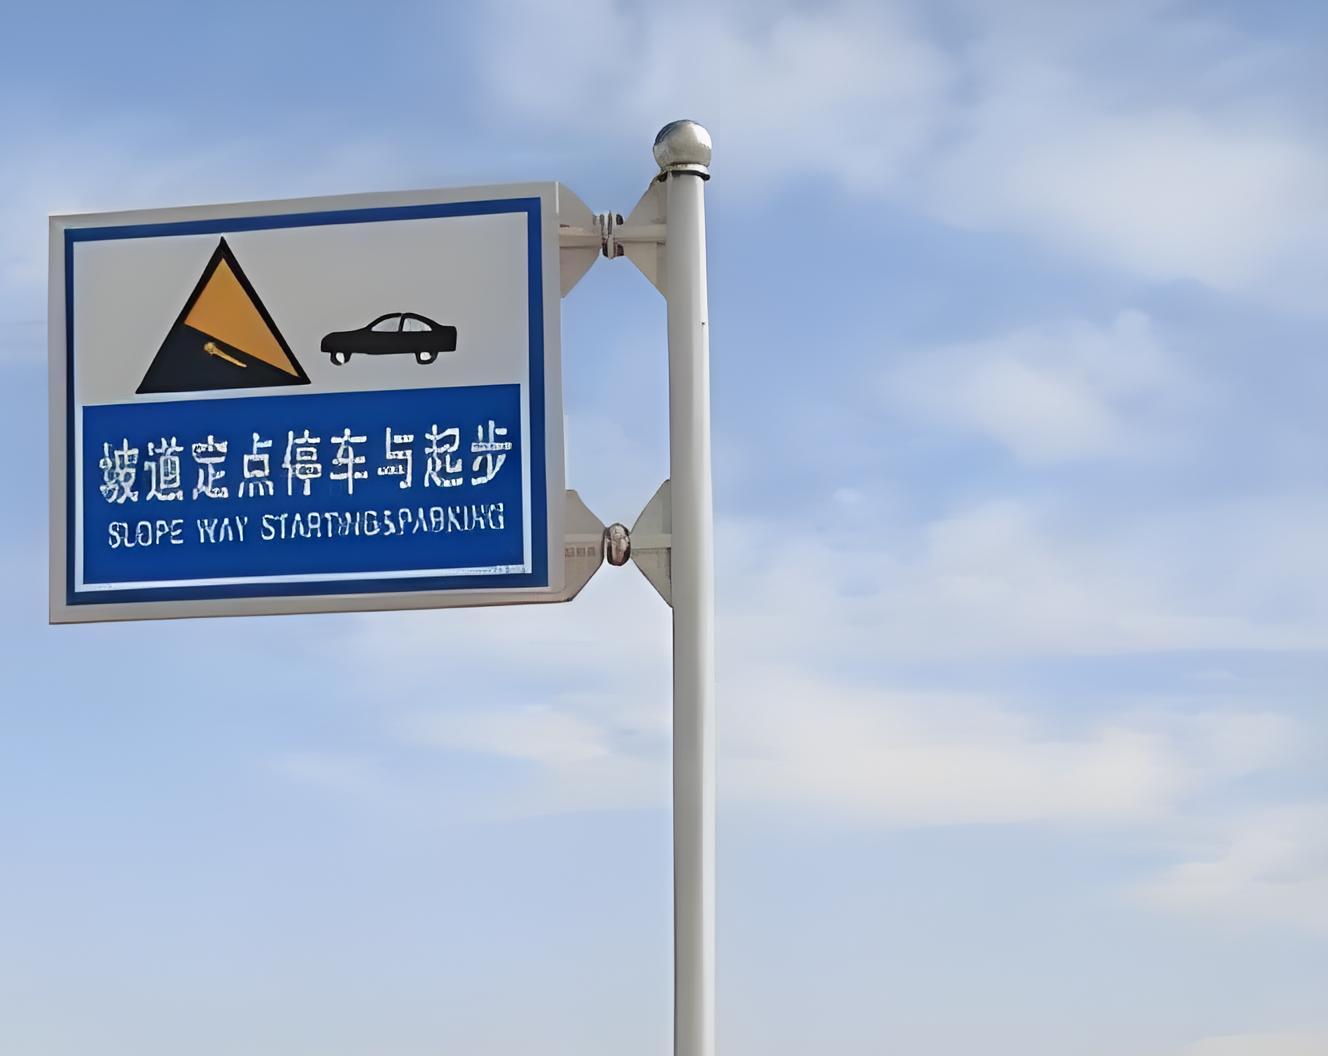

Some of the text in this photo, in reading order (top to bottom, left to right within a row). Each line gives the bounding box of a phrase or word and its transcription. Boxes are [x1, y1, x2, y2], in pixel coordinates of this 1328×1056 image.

[99, 420, 512, 504] 坡道定点停车与起步
[108, 519, 184, 549] SLOPE
[197, 516, 248, 543] WAY
